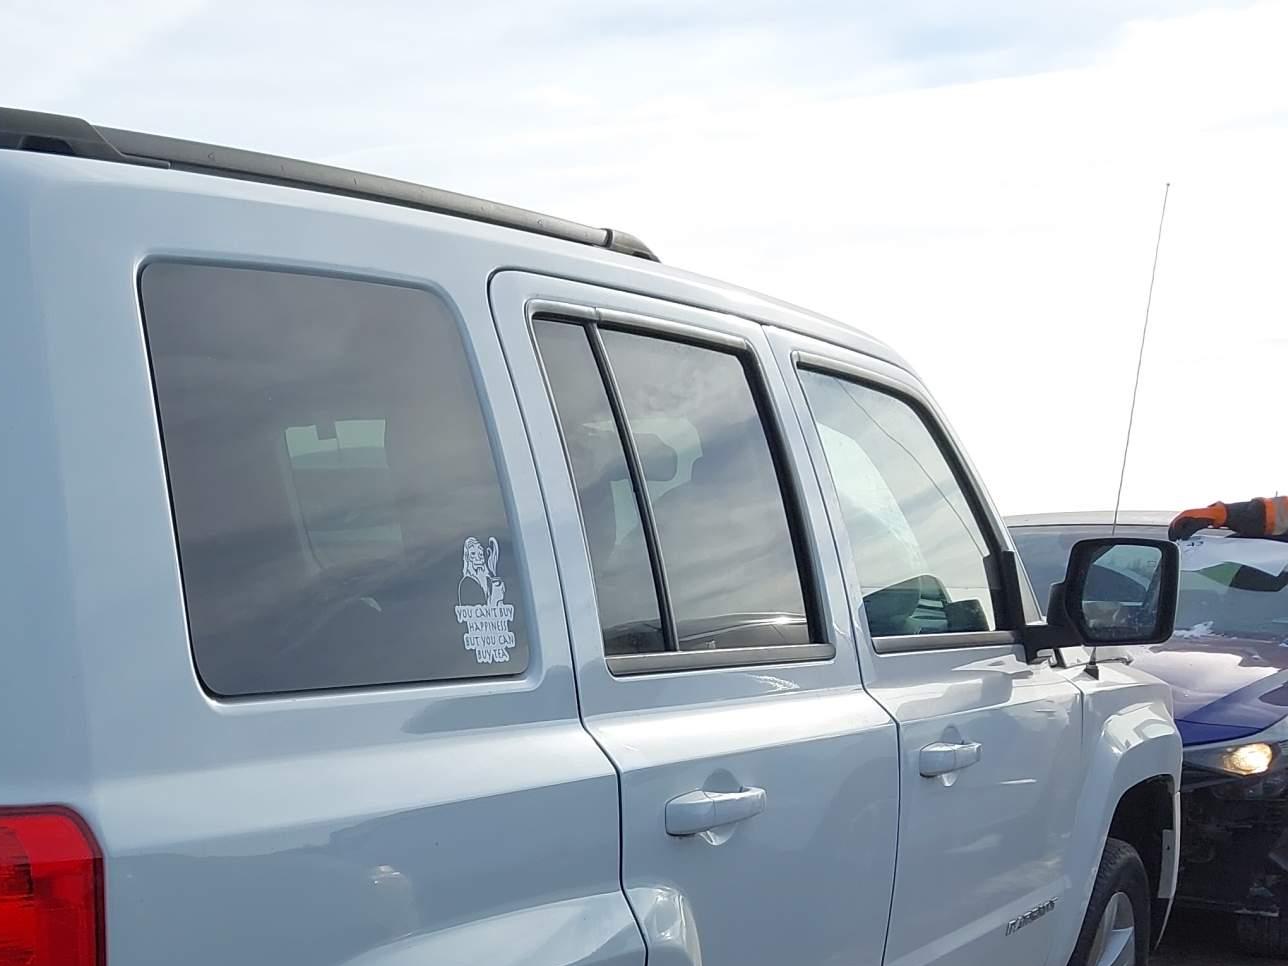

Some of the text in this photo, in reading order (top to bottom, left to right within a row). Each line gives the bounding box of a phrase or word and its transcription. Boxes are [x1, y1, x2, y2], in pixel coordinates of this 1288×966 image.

[456, 607, 473, 619] YOU
[499, 607, 513, 620] BUY
[469, 620, 508, 632] HAPPINESS
[466, 634, 514, 647] BUT YOU CAN
[477, 647, 508, 661] BUY TEA
